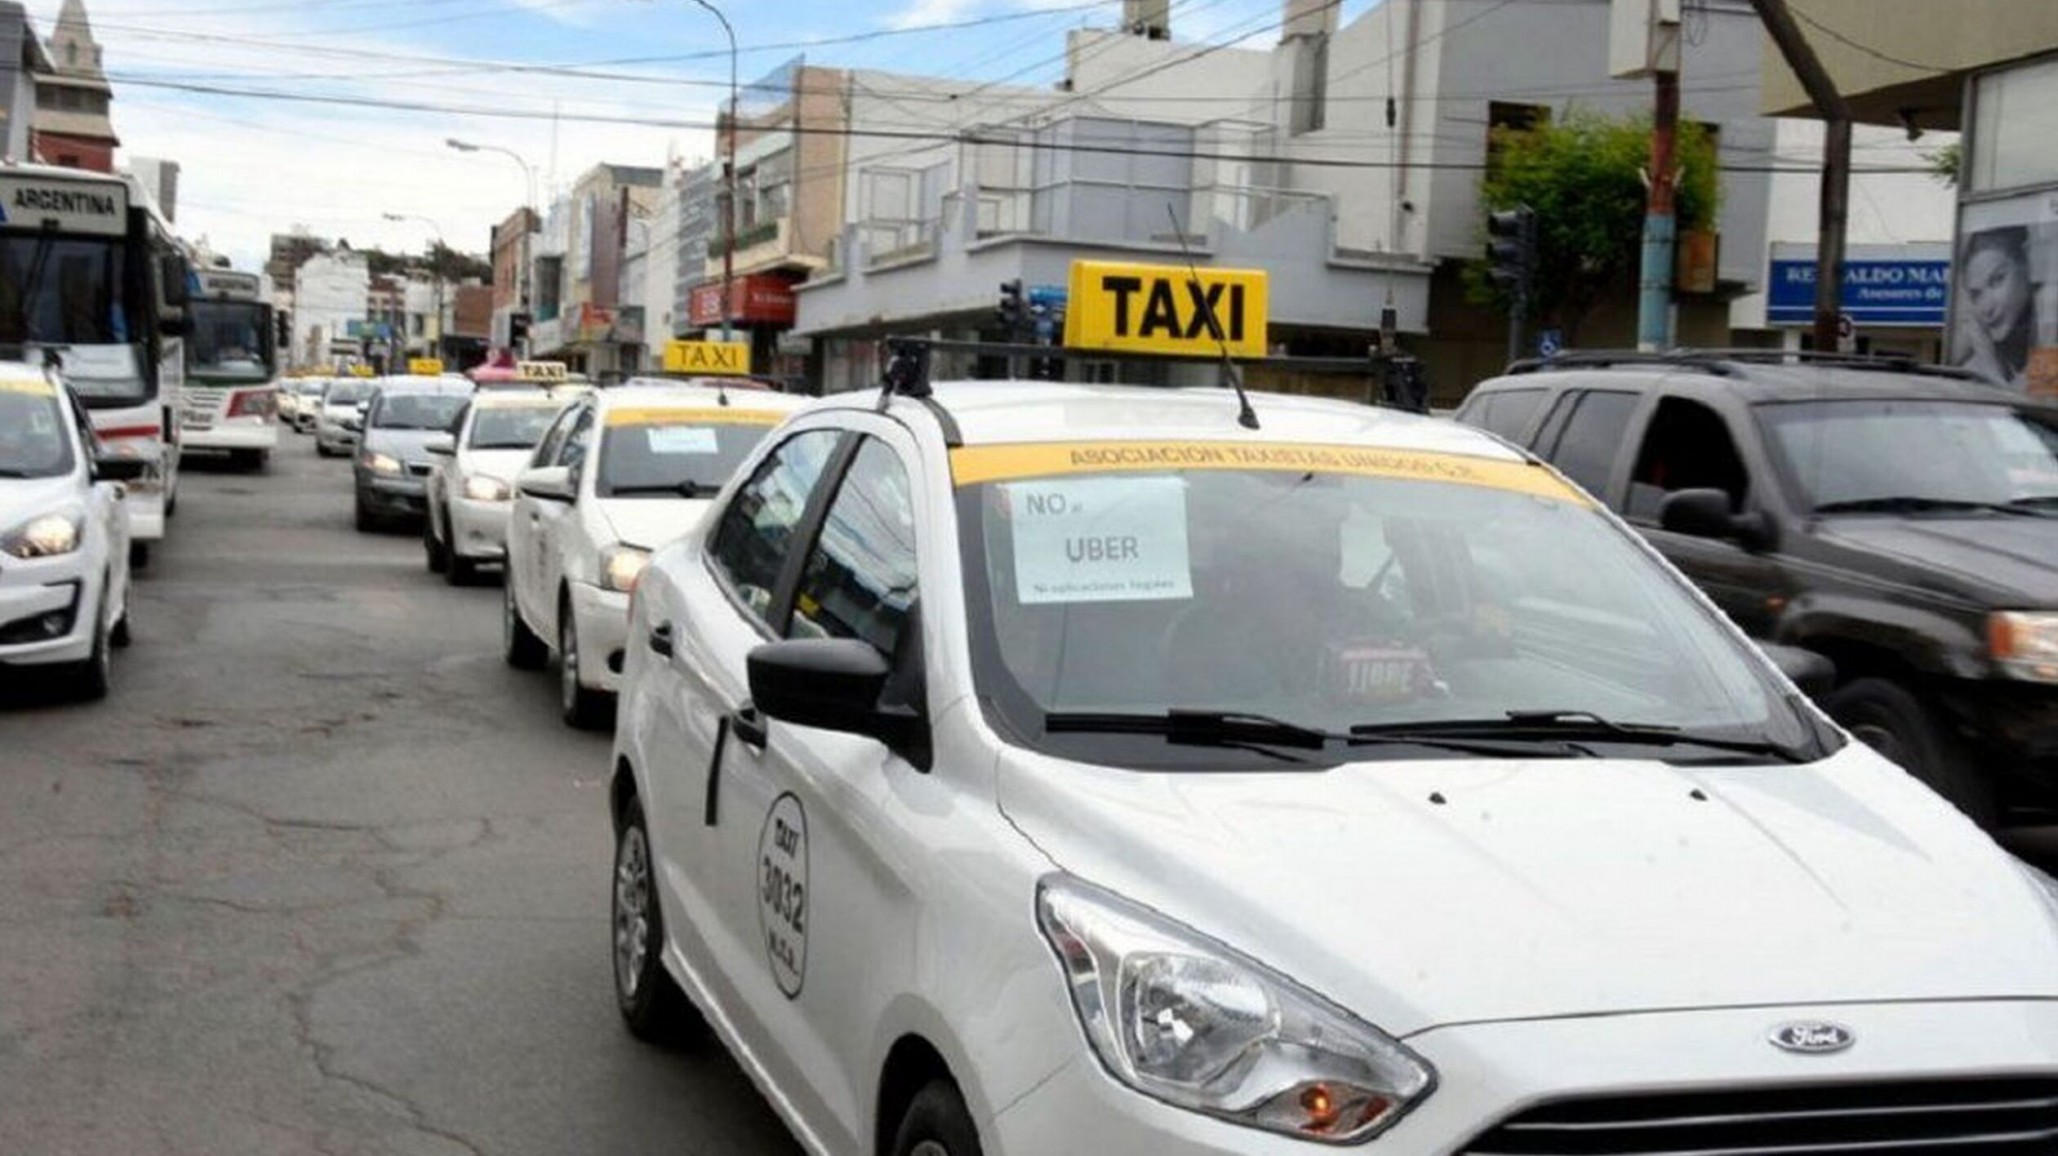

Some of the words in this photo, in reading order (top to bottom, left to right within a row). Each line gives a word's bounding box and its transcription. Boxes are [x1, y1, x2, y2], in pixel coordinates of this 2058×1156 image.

[14, 187, 116, 215] ARGENTINA
[1786, 267, 1904, 284] REALDO
[1102, 276, 1244, 341] TAXI
[677, 345, 737, 368] TAXI
[523, 365, 563, 379] TAXI
[1027, 493, 1067, 516] NO
[1065, 536, 1140, 563] UBER
[775, 818, 800, 860] TAXI
[764, 854, 804, 935] 3032
[1791, 1026, 1839, 1046] Ford
